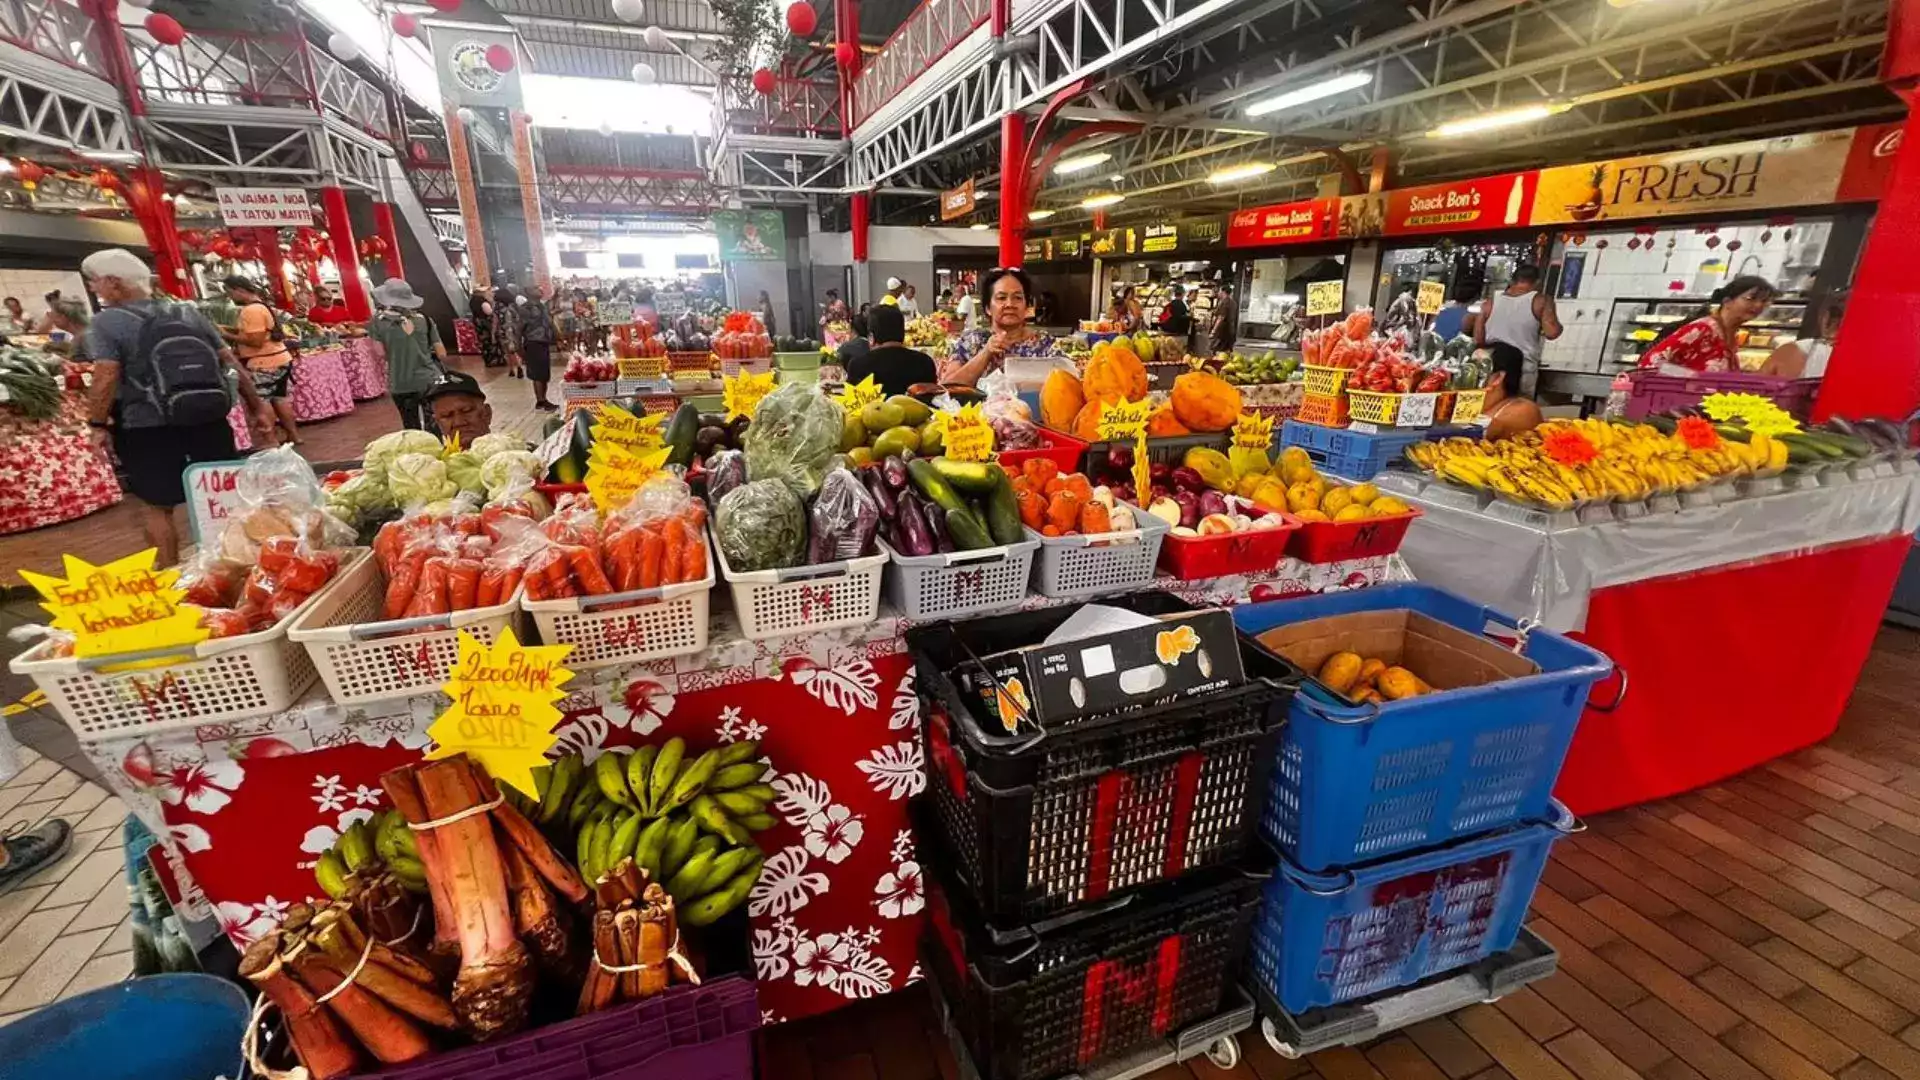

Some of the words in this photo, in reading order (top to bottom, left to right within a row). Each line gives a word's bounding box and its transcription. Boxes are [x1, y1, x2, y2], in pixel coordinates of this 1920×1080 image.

[1611, 151, 1765, 205] FRESH
[283, 194, 306, 204] NOA
[1409, 193, 1446, 213] Snack
[1446, 187, 1481, 208] Bon's
